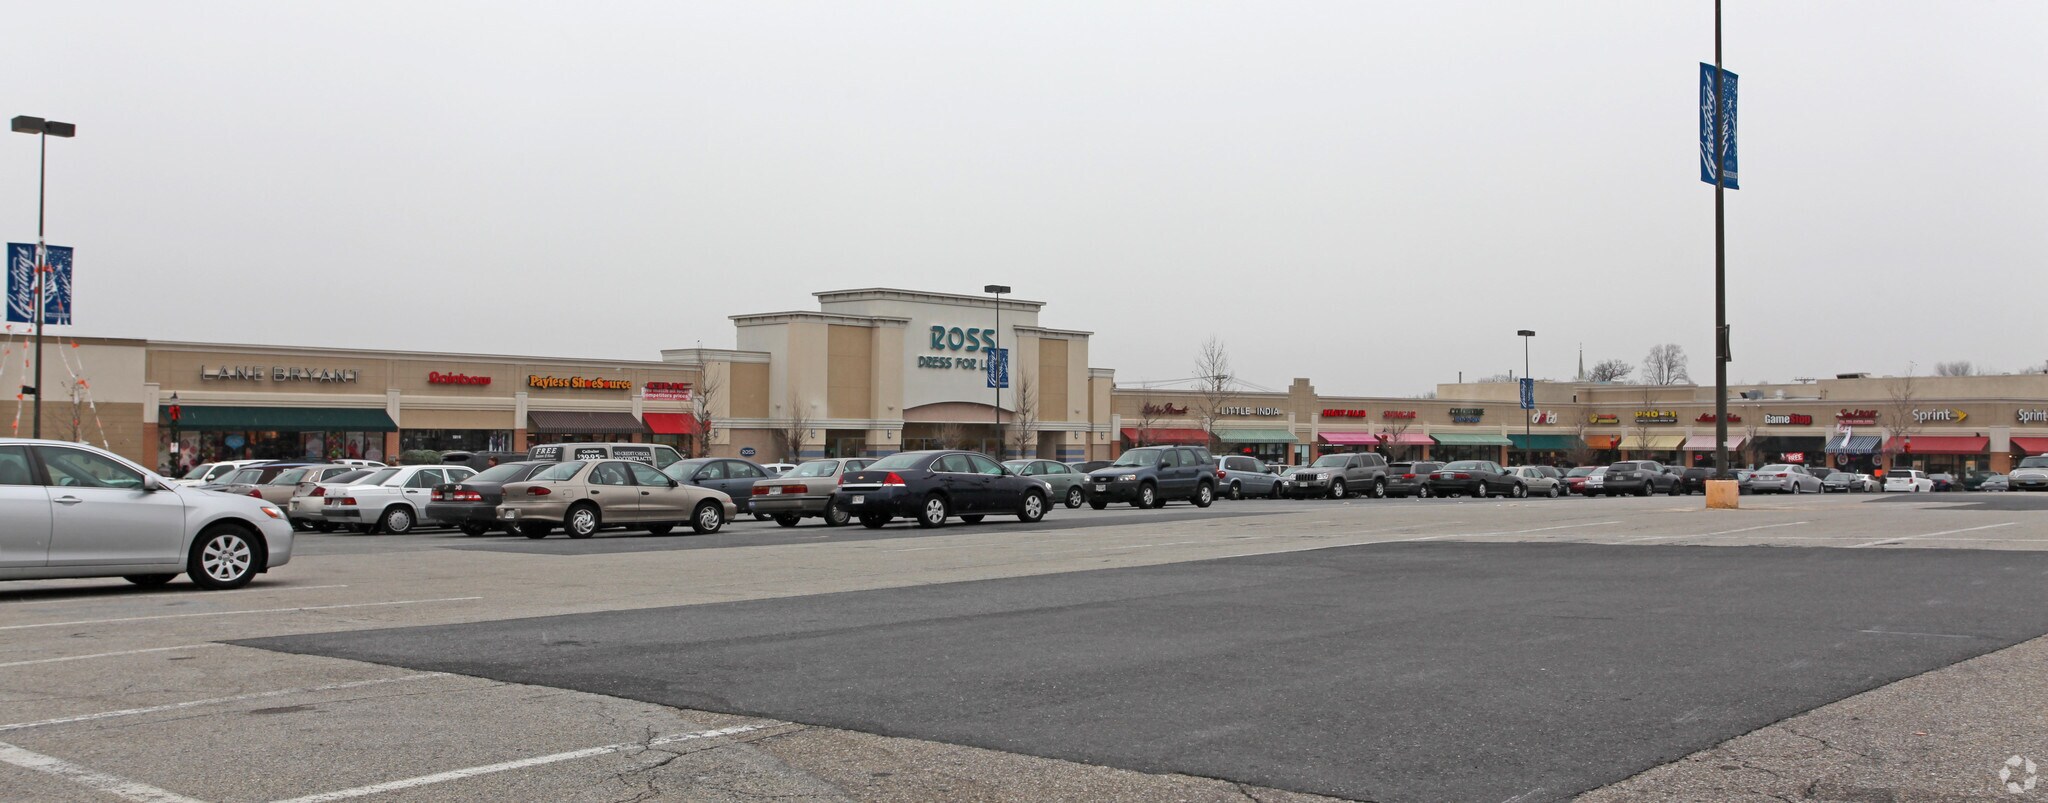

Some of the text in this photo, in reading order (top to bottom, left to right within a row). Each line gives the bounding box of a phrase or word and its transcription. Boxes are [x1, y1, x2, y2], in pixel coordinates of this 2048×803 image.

[930, 325, 996, 353] ROSS
[918, 355, 952, 370] DRESS
[955, 358, 977, 371] FOR
[201, 364, 362, 385] LANE BRYANT
[428, 371, 492, 386] Rainbow
[529, 374, 632, 390] Payless ShoeSource
[1221, 406, 1280, 417] LITTLE INDIA
[1532, 409, 1558, 424] dots
[1764, 413, 1813, 425] GameStop
[1912, 409, 1951, 424] Sprint
[2017, 409, 2048, 424] Sprint
